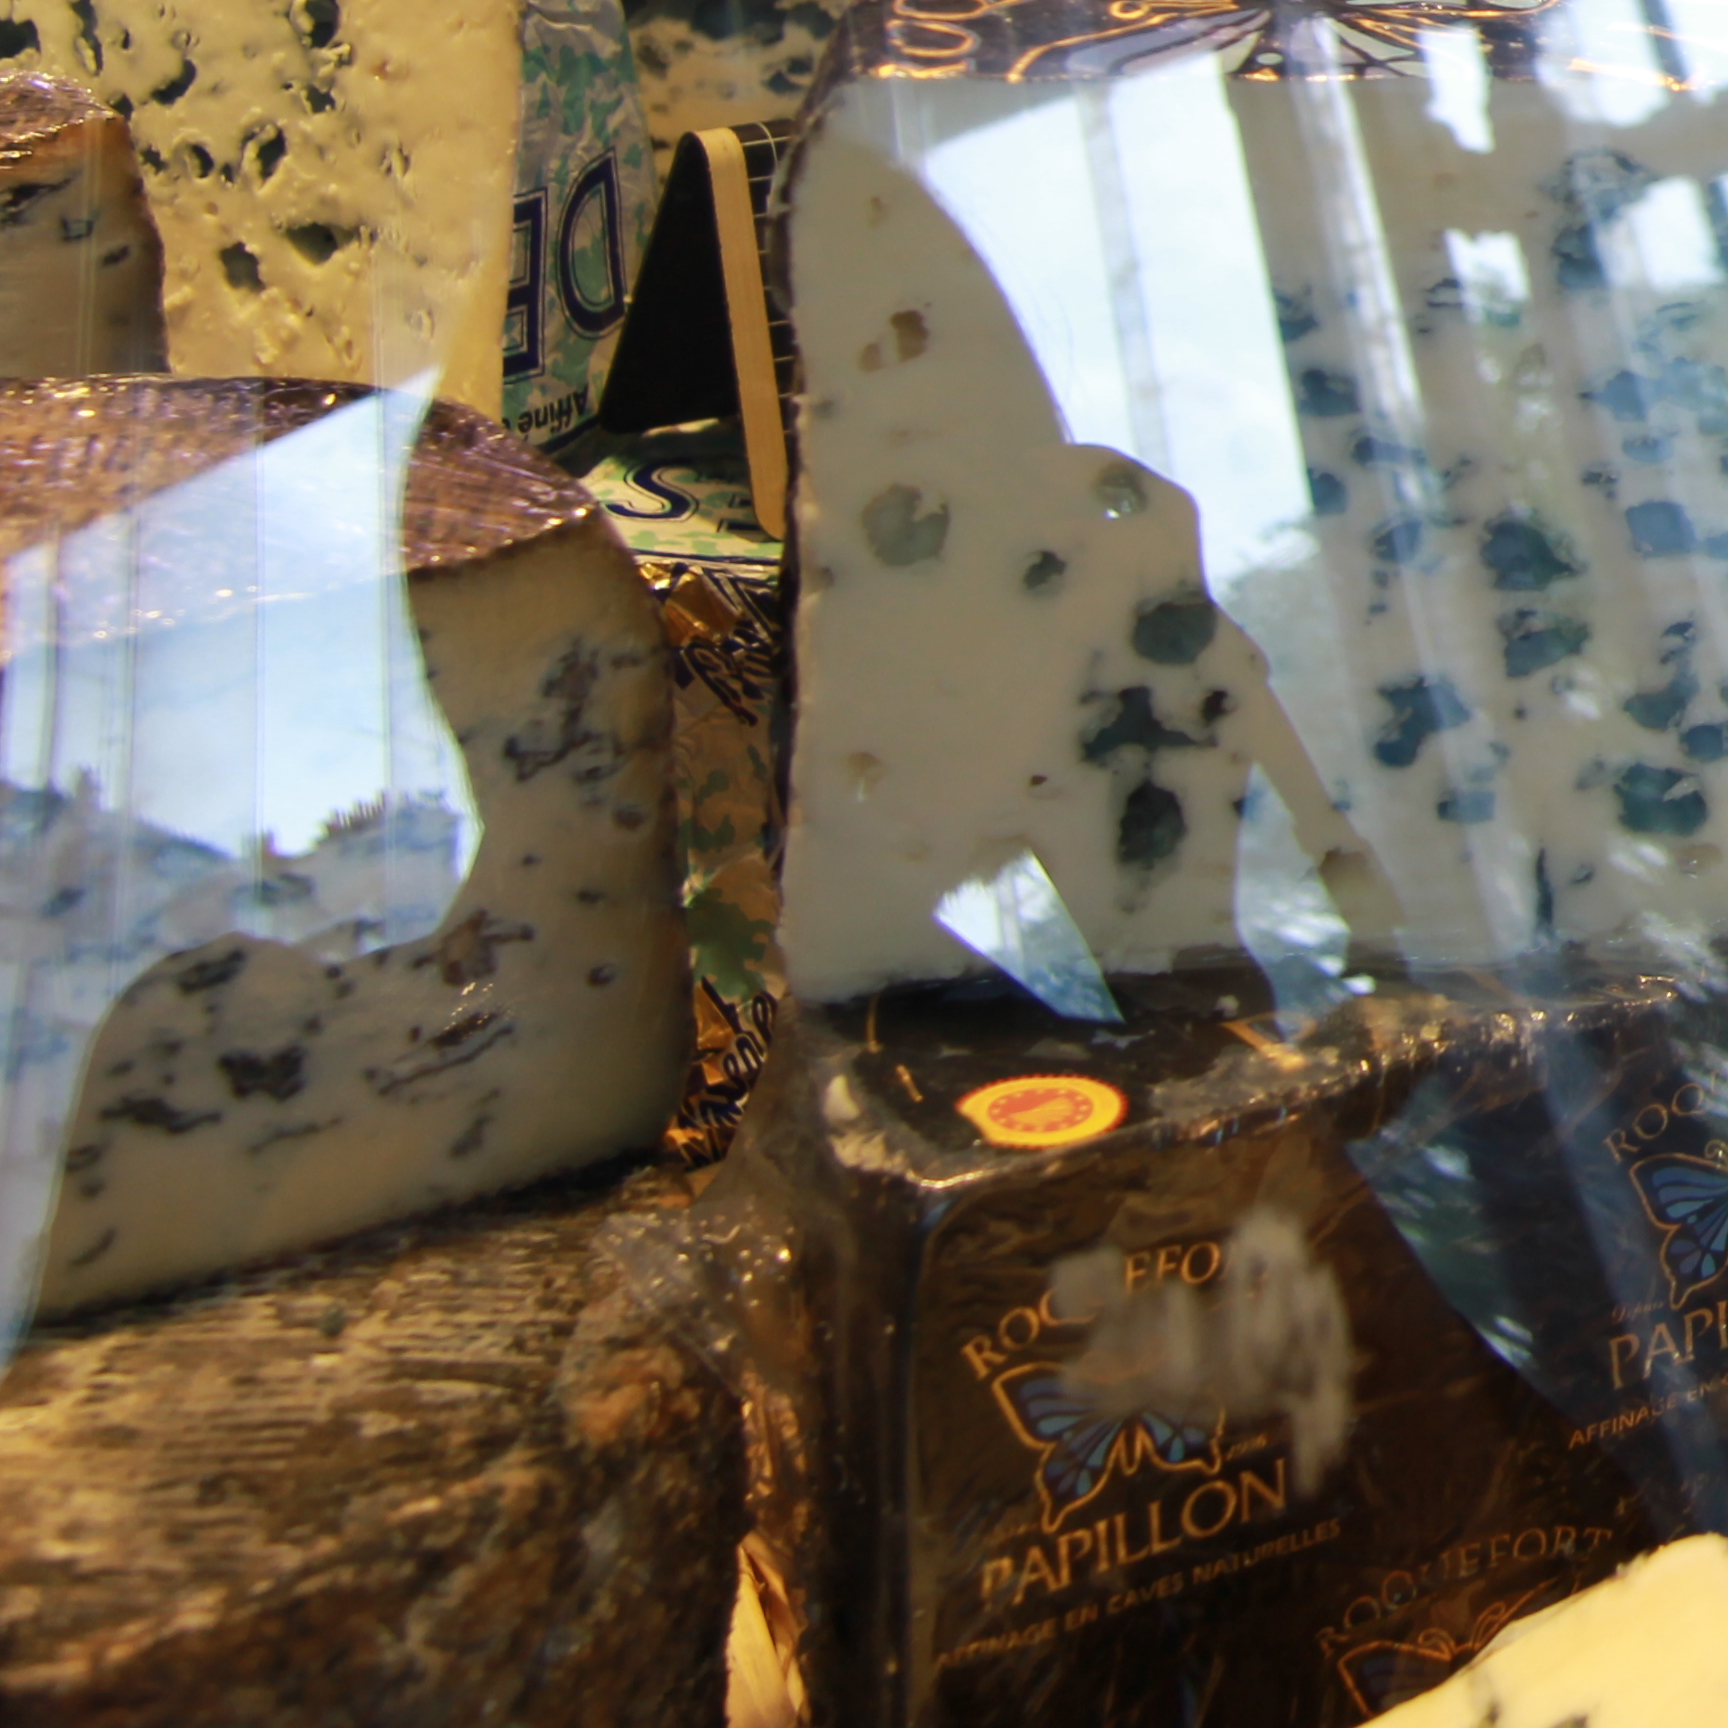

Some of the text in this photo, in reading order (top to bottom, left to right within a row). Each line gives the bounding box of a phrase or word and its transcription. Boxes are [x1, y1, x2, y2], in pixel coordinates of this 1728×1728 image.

[1567, 1392, 1679, 1451] AFFINAGE
[980, 1457, 1287, 1613] PAPILLON
[1106, 1573, 1185, 1615] CAVES
